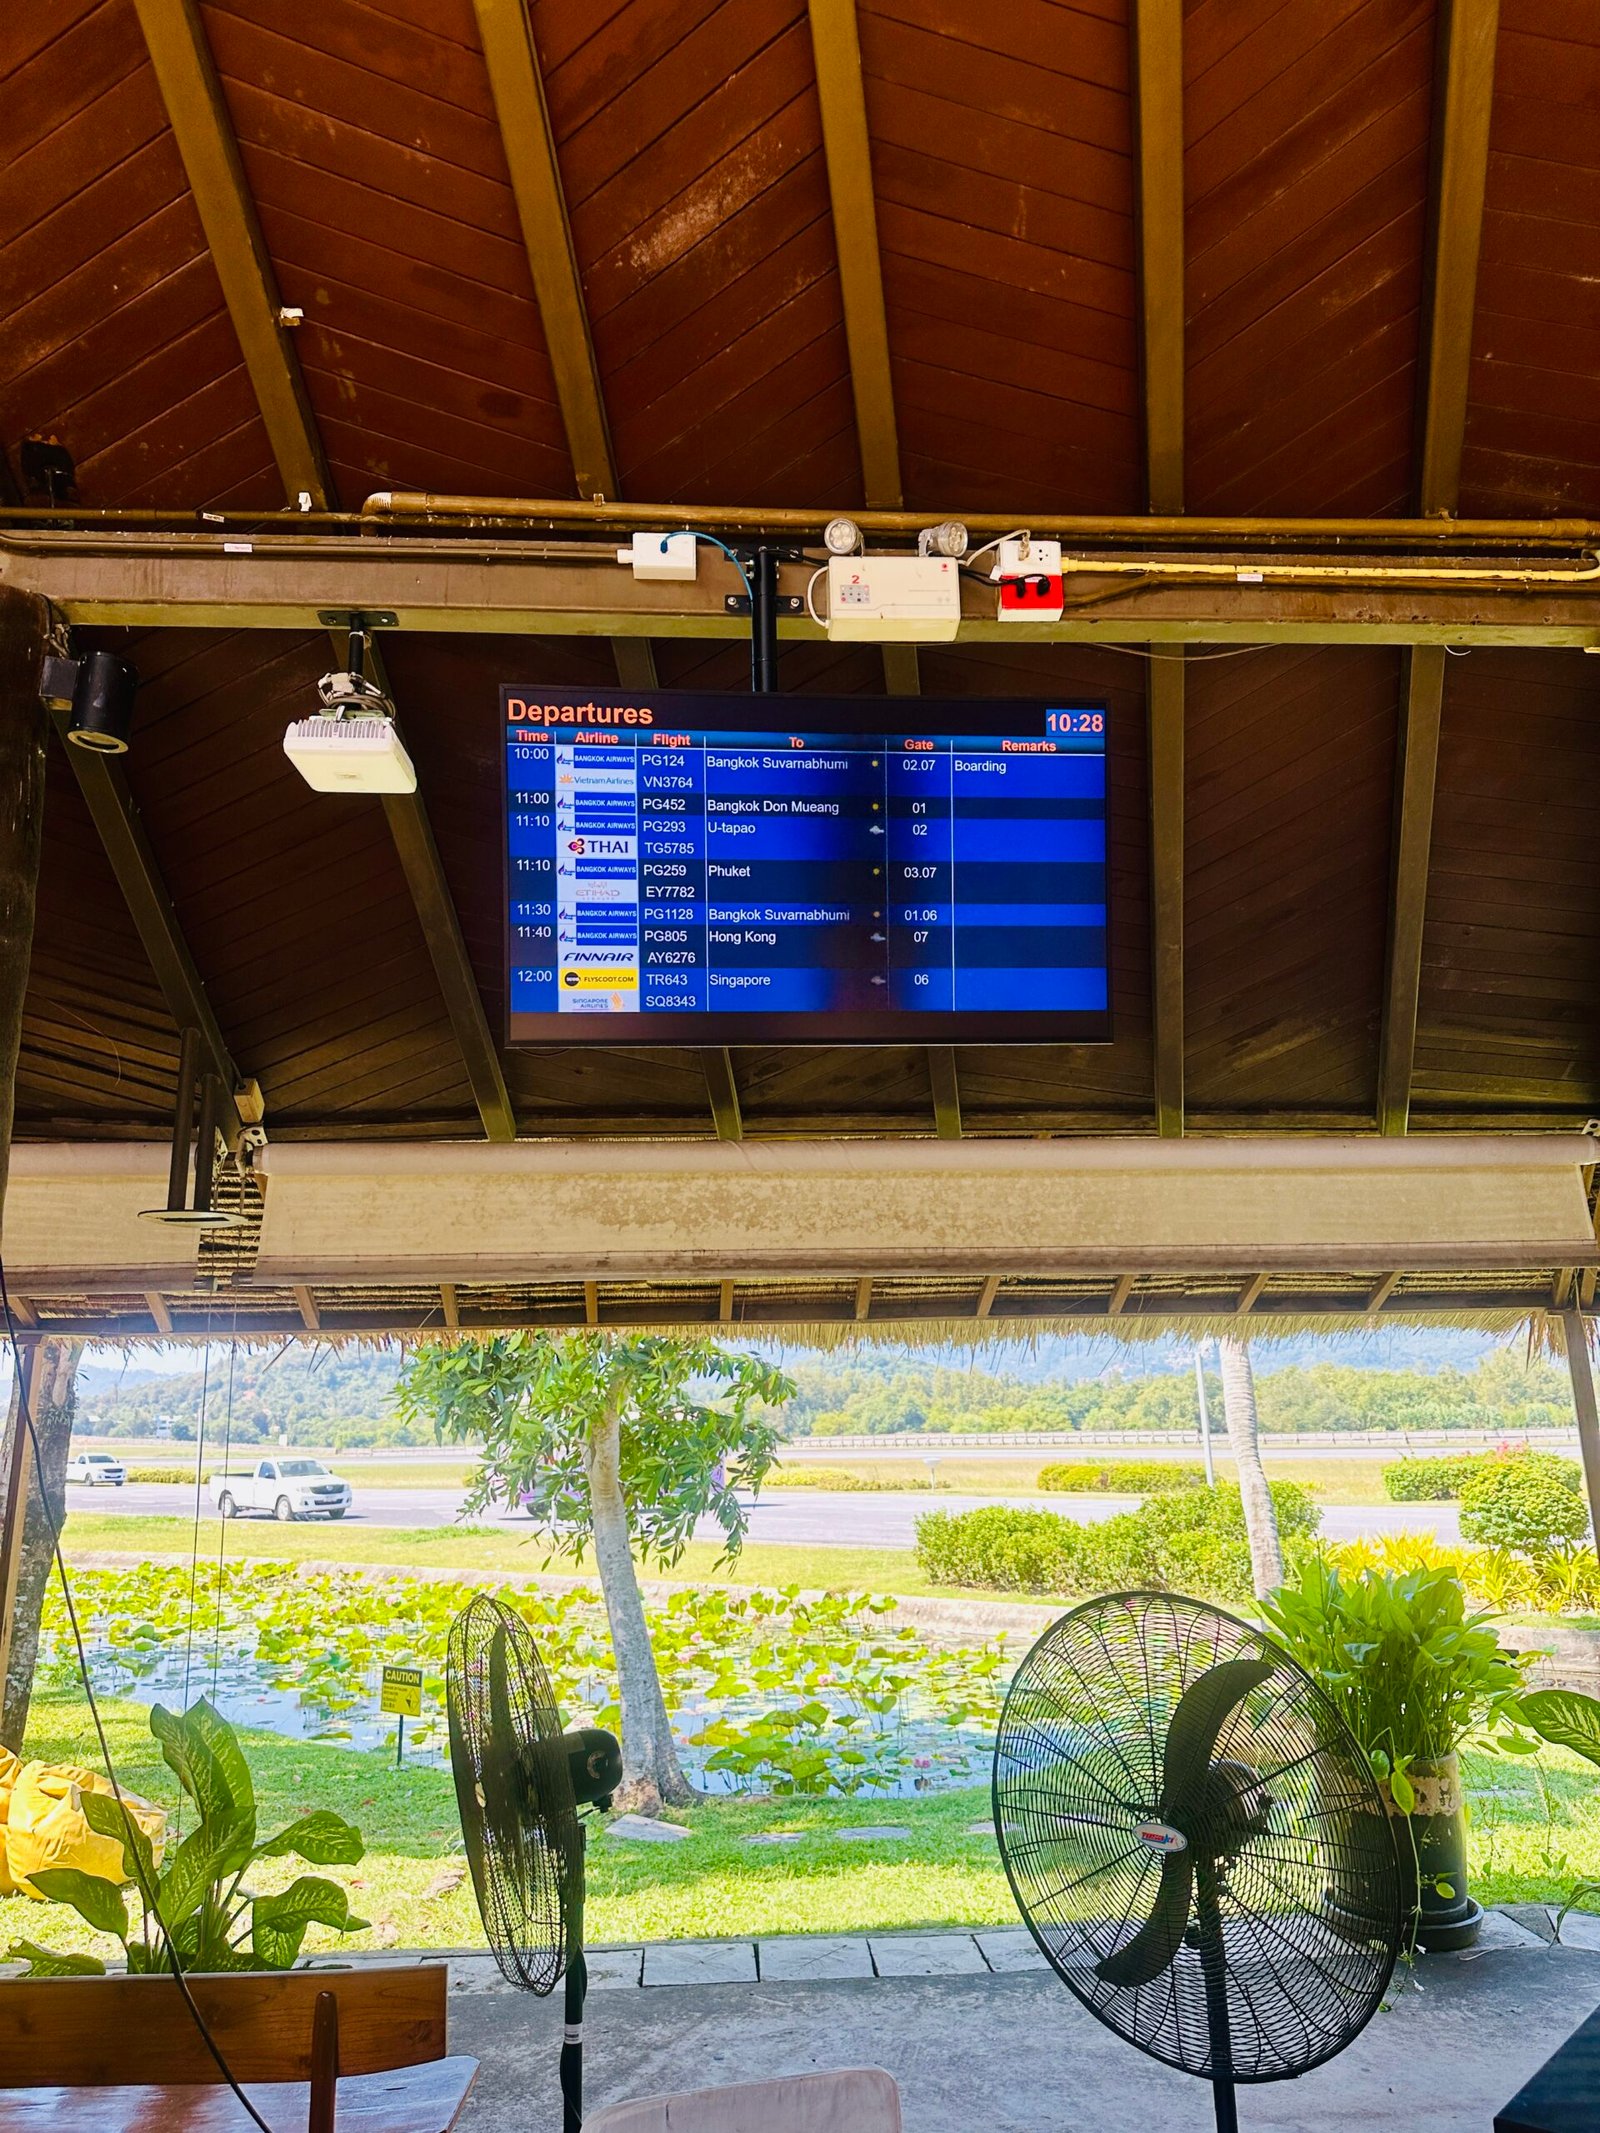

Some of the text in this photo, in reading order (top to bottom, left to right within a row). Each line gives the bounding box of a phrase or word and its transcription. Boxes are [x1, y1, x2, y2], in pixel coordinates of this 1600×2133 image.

[851, 574, 860, 584] 2
[507, 699, 654, 726] Departures
[1047, 713, 1104, 733] 10:28
[516, 730, 1057, 752] Time Airline Flight To Gate Remarks
[514, 748, 550, 760] 10:00
[642, 754, 684, 767] PG124
[707, 756, 849, 770] Bangkok Suvarnabhumi
[903, 760, 936, 771] 02.07
[954, 761, 1007, 774] Boarding
[574, 776, 634, 785] Vietnam Airlines
[643, 776, 693, 788] VN3764
[516, 793, 550, 805] 11:00
[606, 800, 635, 808] AIRWAYS
[642, 798, 686, 811] PG452
[707, 800, 839, 815] Bangkok Don Mueang
[912, 803, 926, 814] 01
[516, 815, 550, 827] 11:10
[643, 820, 686, 833] PG293
[708, 822, 756, 836] U-tapao
[912, 825, 928, 836] 02
[587, 840, 628, 854] THAI
[645, 842, 695, 855] TG5785
[516, 860, 551, 871] 11:10
[643, 864, 687, 877] PG259
[708, 865, 751, 877] Phuket
[904, 867, 937, 879] 03.07
[576, 889, 620, 897] ETIHAD
[646, 886, 695, 898] EY7782
[517, 904, 551, 916] 11:30
[608, 910, 637, 918] AIRWAYS
[644, 908, 694, 920] PG1128
[709, 909, 850, 922] Bangkok Suvarnabhumi
[904, 910, 938, 922] 01.06
[517, 926, 552, 938] 11:40
[644, 930, 688, 943] PG805
[709, 931, 777, 945] Hong Kong
[913, 932, 929, 943] 07
[563, 952, 634, 962] FINNAIR
[647, 951, 696, 964] AY6276
[517, 970, 553, 982] 12:00
[646, 974, 688, 986] TR643
[709, 974, 771, 987] Singapore
[914, 974, 929, 986] 06
[645, 995, 696, 1008] SQ8343
[385, 1670, 420, 1684] CAUTION
